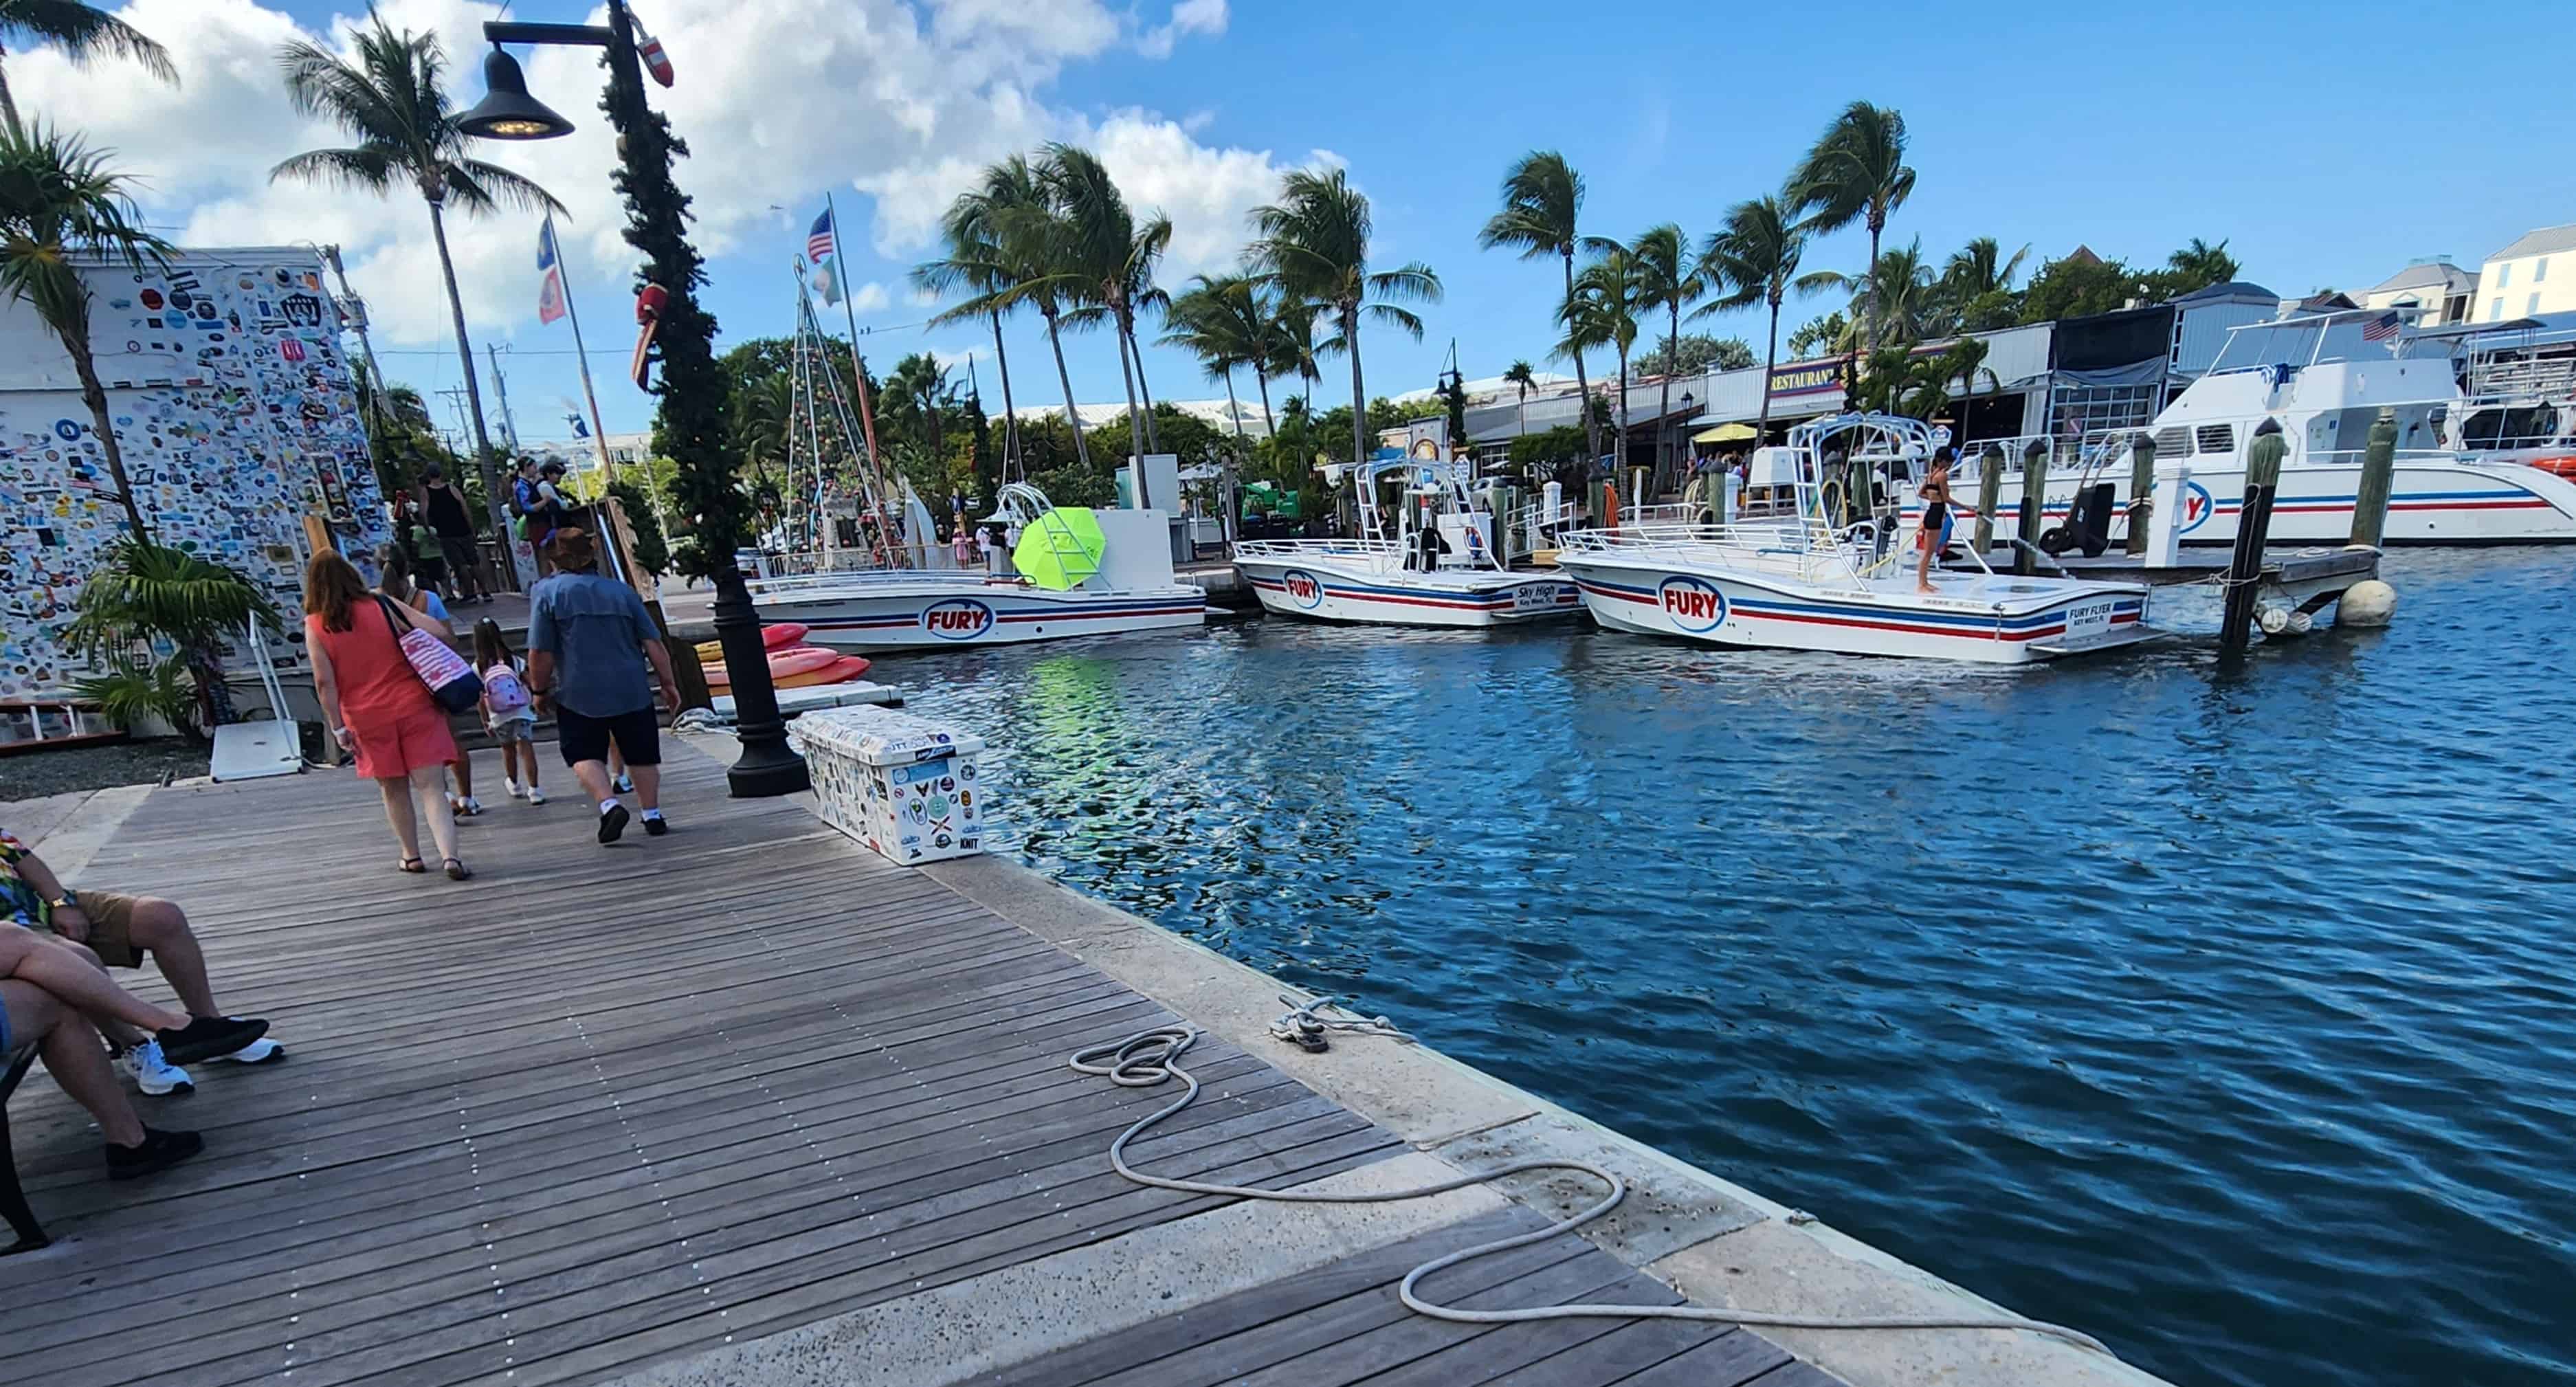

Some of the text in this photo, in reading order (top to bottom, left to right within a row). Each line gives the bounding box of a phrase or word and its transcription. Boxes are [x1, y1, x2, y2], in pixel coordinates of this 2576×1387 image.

[1287, 579, 1316, 599] FURY
[1518, 585, 1555, 599] Sky High
[1664, 589, 1718, 619] FURY
[2069, 603, 2111, 619] FURY FLYER
[926, 610, 986, 630] FURY
